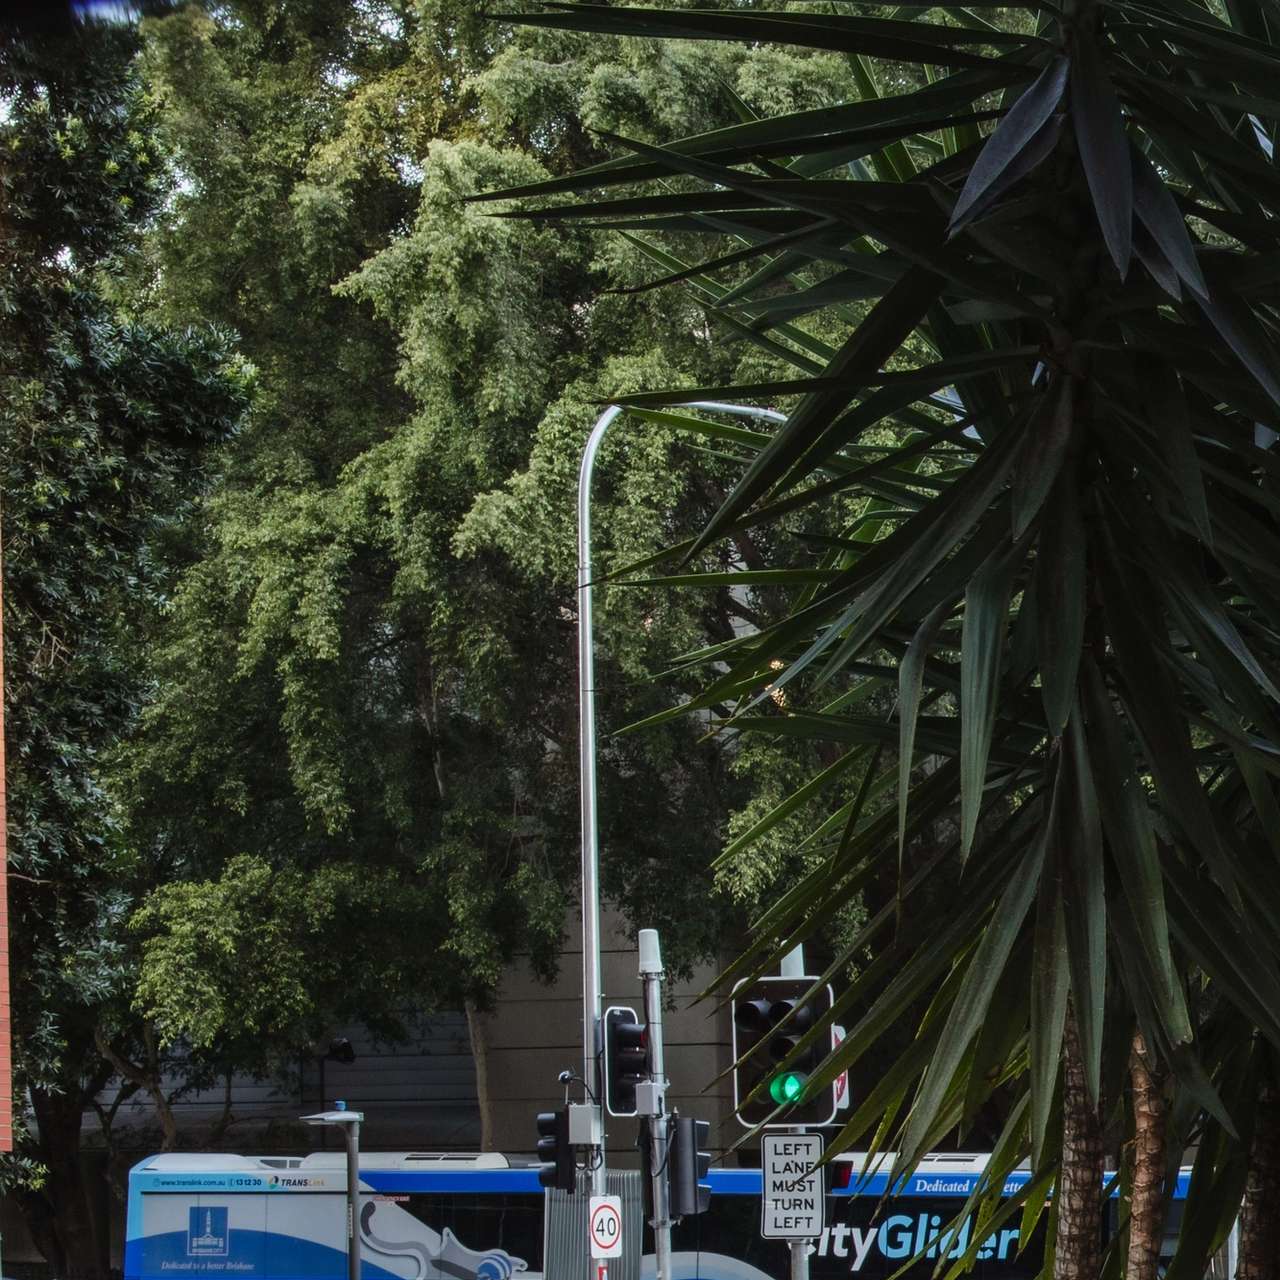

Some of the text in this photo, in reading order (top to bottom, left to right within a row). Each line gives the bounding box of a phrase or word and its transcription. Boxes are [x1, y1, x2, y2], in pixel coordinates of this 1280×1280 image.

[774, 1143, 812, 1155] LEFT
[772, 1161, 814, 1174] LANE
[772, 1180, 815, 1192] MUST
[916, 1179, 969, 1193] Dedicated
[772, 1198, 814, 1210] TURN
[596, 1217, 616, 1237] 40
[774, 1216, 813, 1229] LEFT
[788, 1213, 1020, 1271] ityGlider
